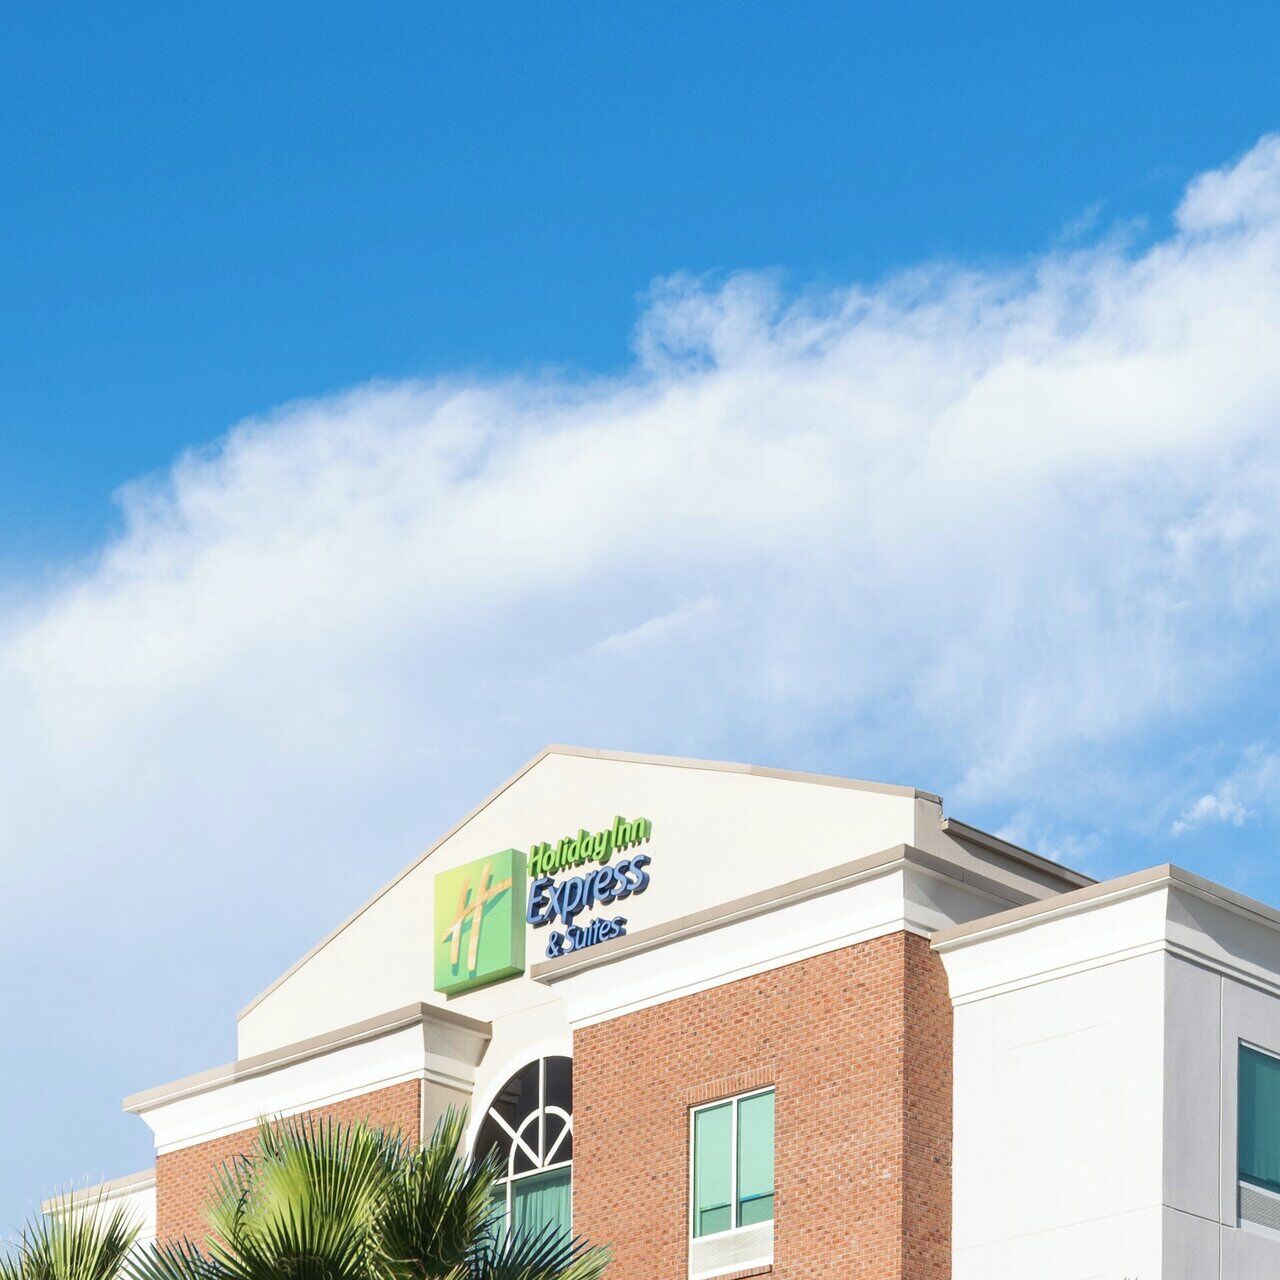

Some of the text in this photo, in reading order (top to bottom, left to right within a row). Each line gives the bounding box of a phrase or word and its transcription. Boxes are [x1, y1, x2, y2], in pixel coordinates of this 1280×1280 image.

[527, 816, 651, 878] Holiday Inn
[526, 854, 651, 926] Express
[546, 916, 627, 958] & Suites
